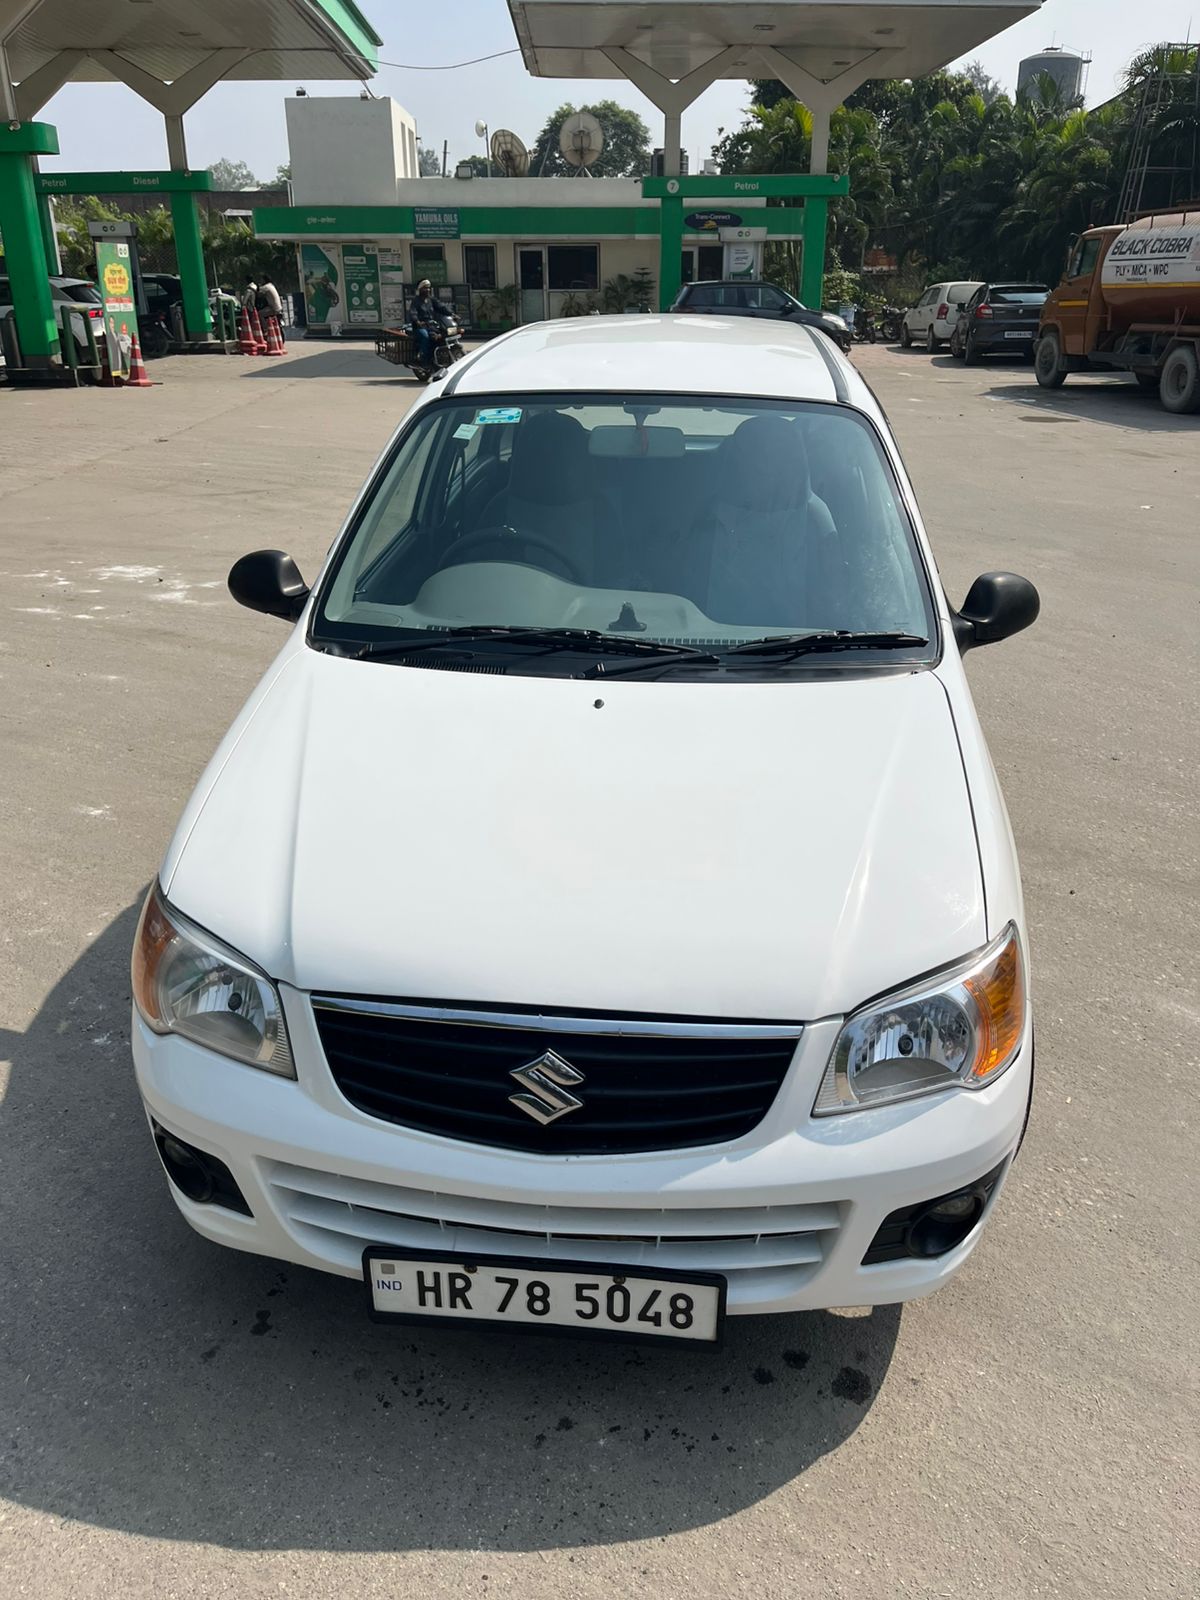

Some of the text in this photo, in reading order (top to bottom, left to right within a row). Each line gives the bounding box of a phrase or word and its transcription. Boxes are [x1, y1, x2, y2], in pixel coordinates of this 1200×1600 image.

[41, 179, 67, 187] Petrol
[133, 177, 159, 185] Diesel
[734, 182, 759, 190] Petrol
[415, 213, 458, 223] YAMUNA OILS
[1111, 237, 1192, 255] BLACK COBRA
[1115, 263, 1169, 277] PLY MICA WPC
[376, 1279, 402, 1291] IND
[416, 1270, 694, 1330] HR 78 5048
